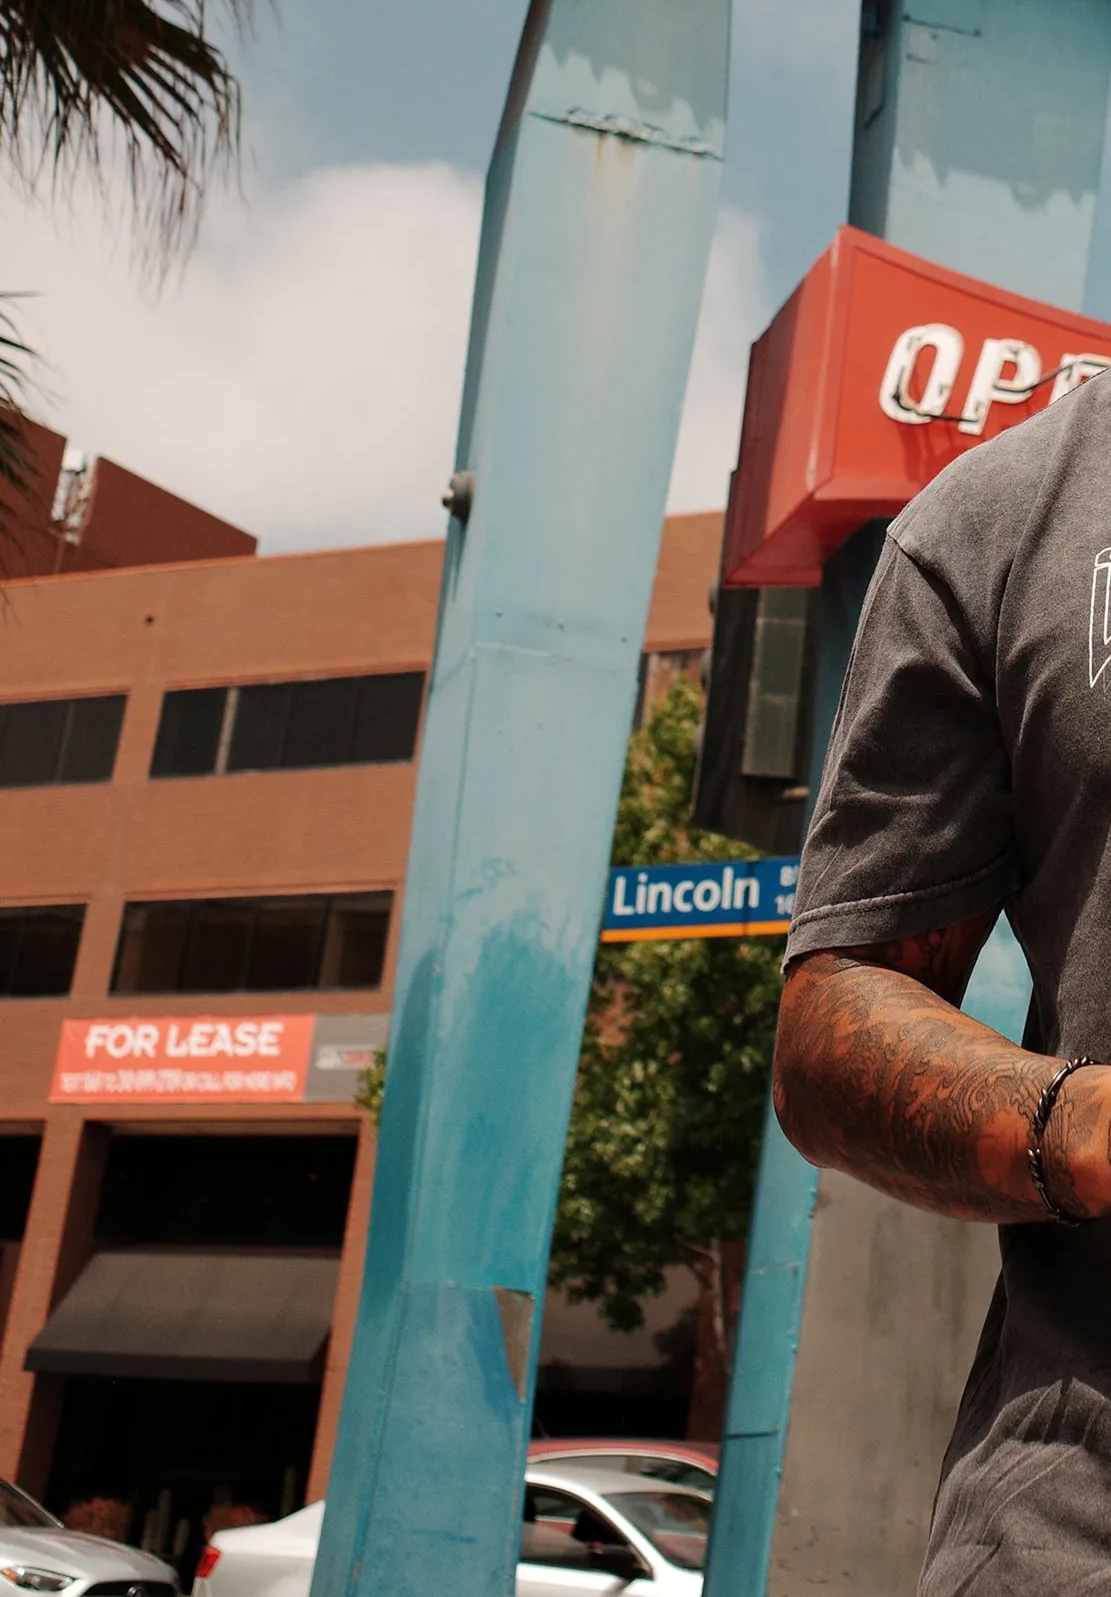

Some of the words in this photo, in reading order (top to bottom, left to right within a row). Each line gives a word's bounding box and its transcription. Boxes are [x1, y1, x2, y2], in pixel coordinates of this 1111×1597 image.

[613, 866, 760, 916] Lincoln
[85, 1024, 160, 1058] FOR
[166, 1021, 285, 1057] LEASE
